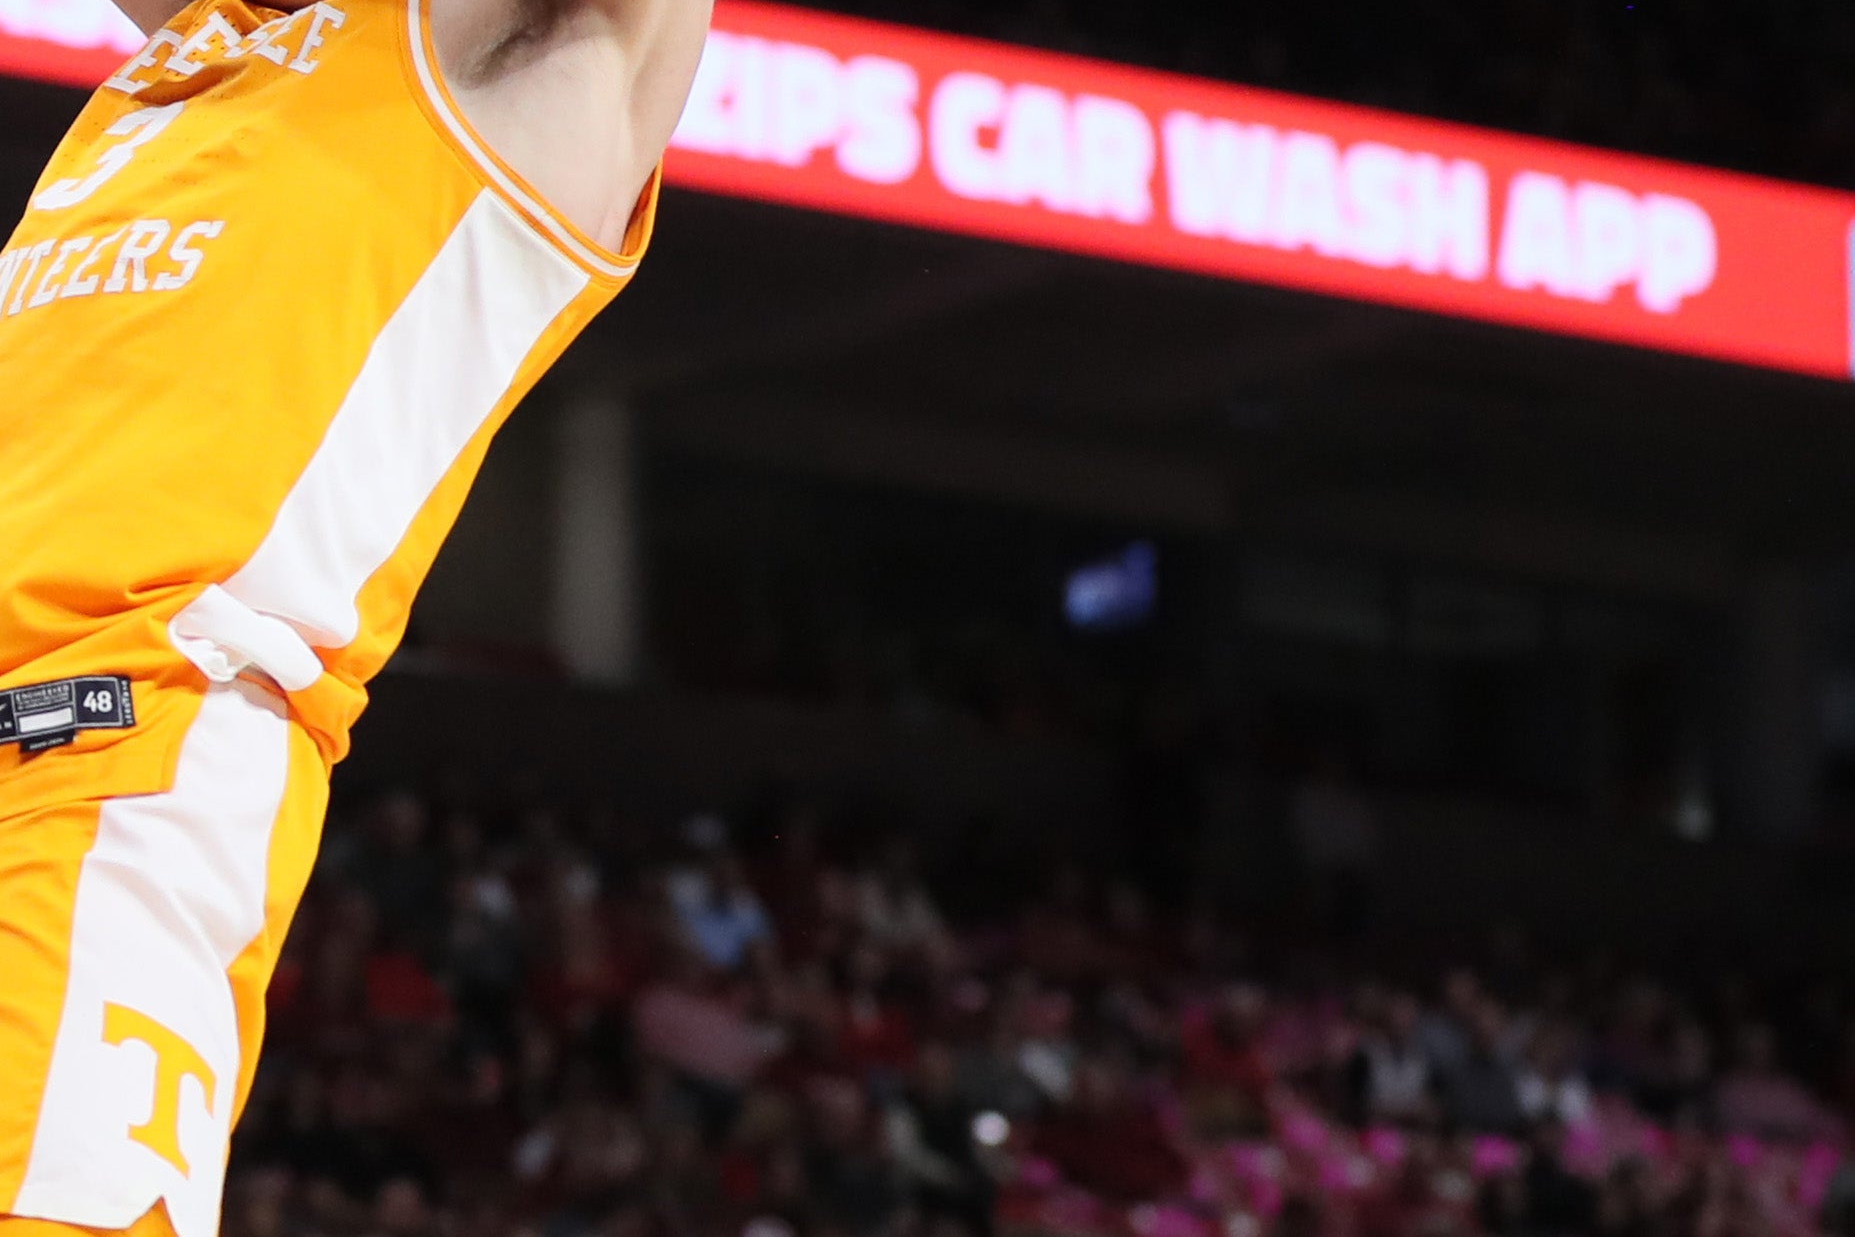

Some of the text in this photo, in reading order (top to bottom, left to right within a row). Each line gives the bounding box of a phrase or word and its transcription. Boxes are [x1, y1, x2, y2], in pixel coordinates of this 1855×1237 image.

[31, 101, 185, 211] 3
[928, 72, 1157, 227] CAR
[1162, 110, 1492, 282] WASH
[1497, 171, 1718, 314] APP
[83, 689, 114, 713] 48
[102, 1000, 217, 1177] T
